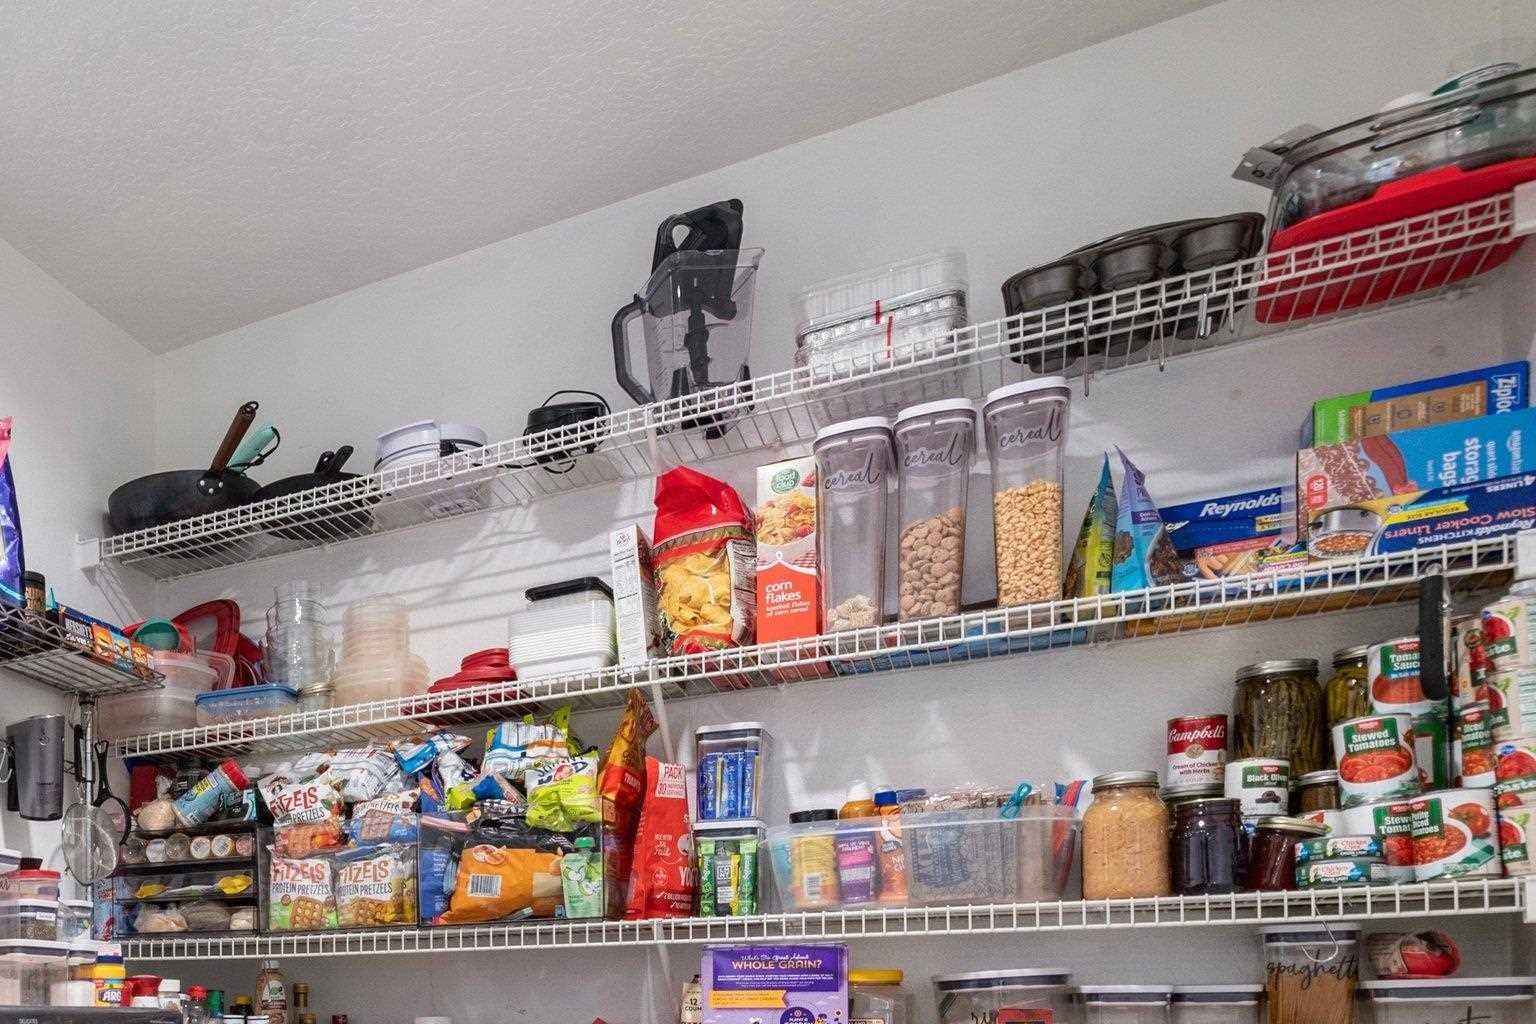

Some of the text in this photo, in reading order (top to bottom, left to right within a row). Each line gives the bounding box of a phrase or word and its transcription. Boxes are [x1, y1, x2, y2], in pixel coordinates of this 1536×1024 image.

[999, 407, 1062, 448] cereal
[904, 432, 964, 467] cereal
[1464, 437, 1481, 484] storag
[825, 451, 882, 490] cereal
[1199, 492, 1282, 518] Reynolds
[1384, 506, 1536, 540] Slow Cooker Liners
[1417, 530, 1476, 545] KITCHENS
[765, 580, 793, 593] corn
[765, 591, 801, 605] flakes
[1352, 729, 1389, 744] Stewed
[1348, 737, 1397, 752] Tomatoes
[292, 807, 325, 823] PRETZELS
[272, 881, 331, 895] PROTEIN PRETZELS
[360, 882, 393, 896] PRETZELS
[732, 959, 823, 970] WHOLE GRAIN?
[1265, 949, 1361, 991] spaghetti
[689, 998, 698, 1006] 12
